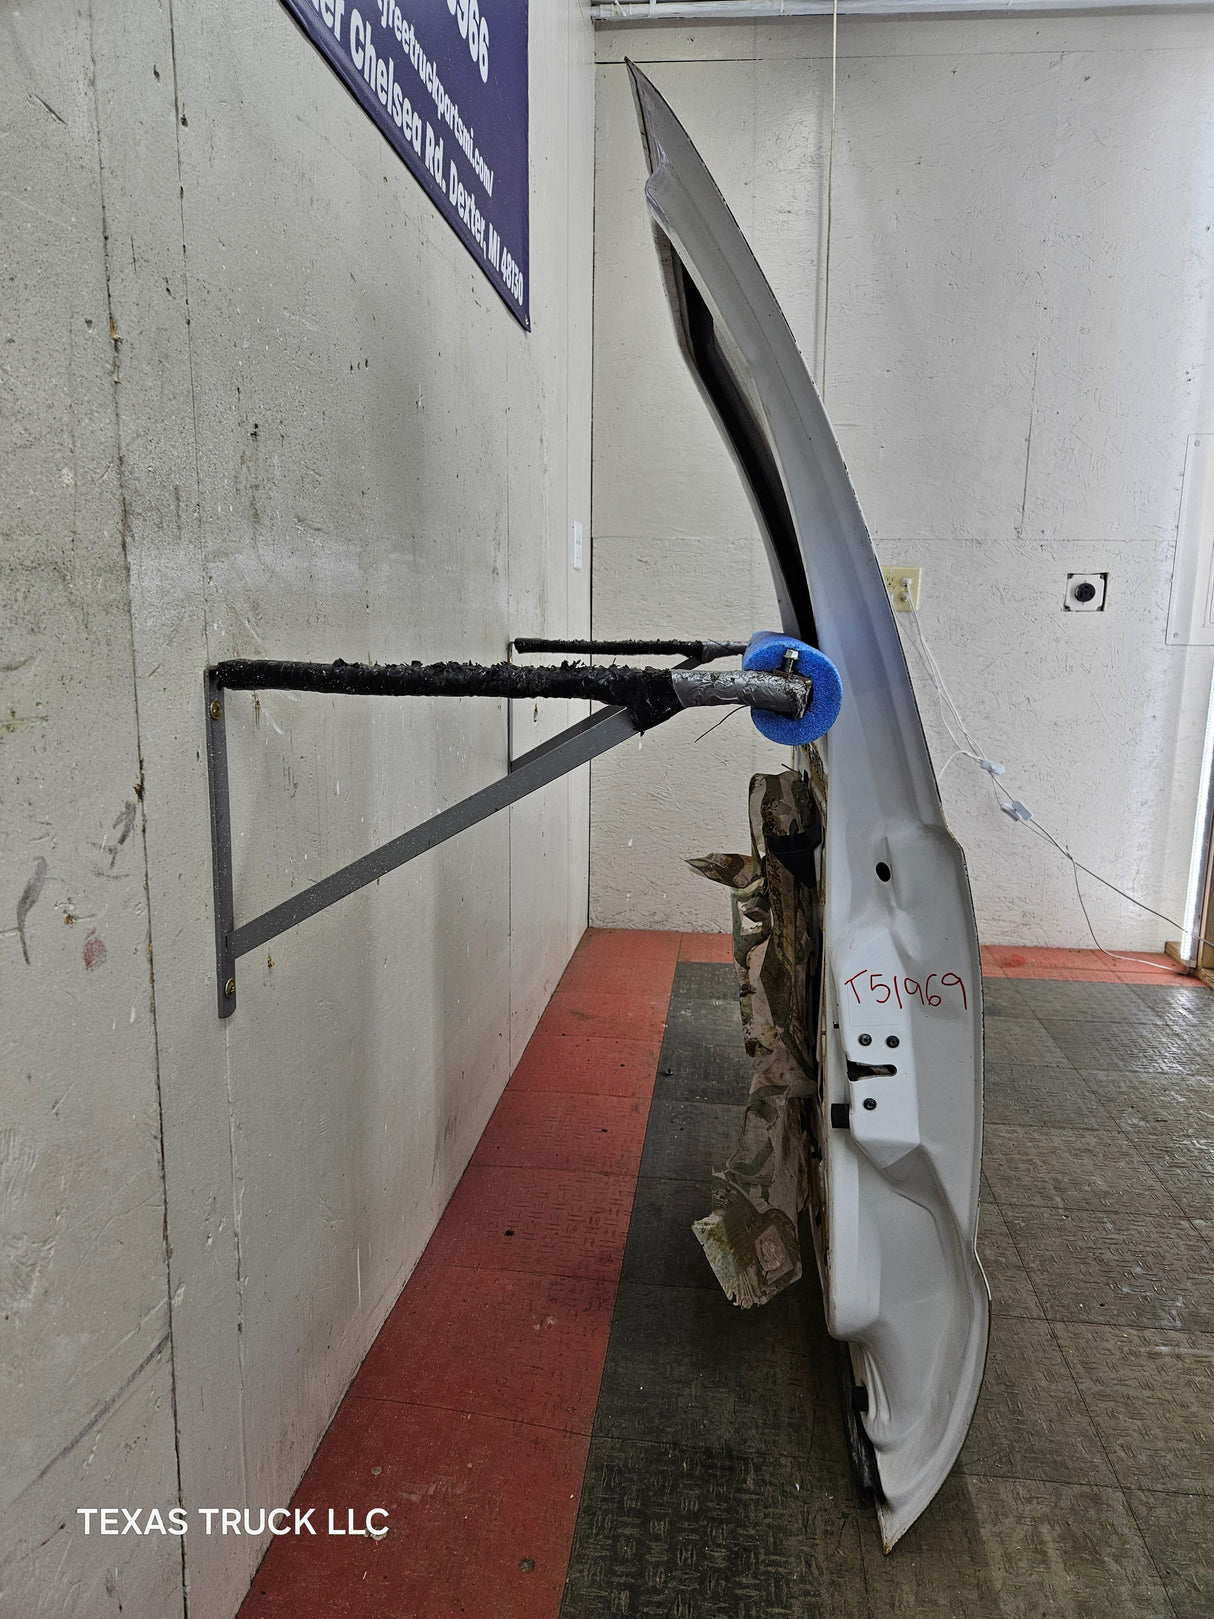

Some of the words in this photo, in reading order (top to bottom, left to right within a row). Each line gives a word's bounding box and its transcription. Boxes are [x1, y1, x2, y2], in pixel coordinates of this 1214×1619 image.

[376, 0, 494, 197] reetruckpartsmi.com/
[446, 0, 489, 83] 966
[311, 0, 344, 41] er
[350, 8, 422, 157] Chelsea
[425, 121, 446, 193] Rd.
[449, 159, 486, 259] Dexter,
[488, 222, 500, 272] MI
[501, 246, 523, 306] 48130
[844, 969, 967, 1010] T51969
